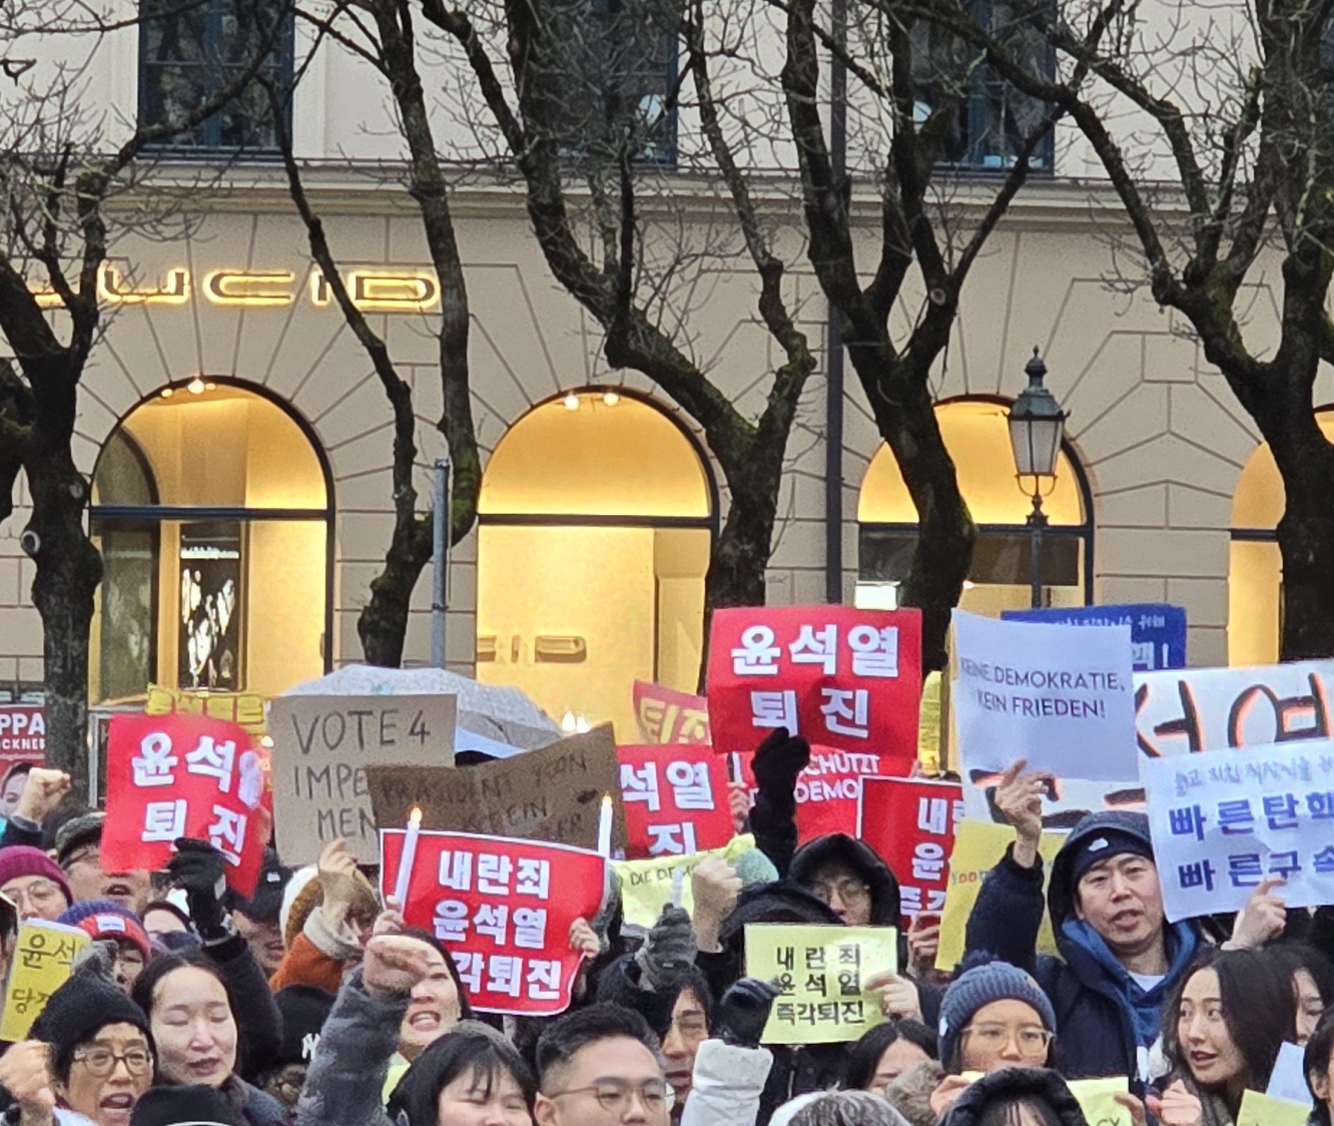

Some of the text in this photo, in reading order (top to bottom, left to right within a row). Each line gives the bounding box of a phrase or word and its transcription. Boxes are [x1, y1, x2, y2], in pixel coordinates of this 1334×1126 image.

[731, 623, 900, 678] 윤석열
[994, 666, 1126, 693] DEMOKRATIE,
[750, 687, 870, 739] 퇴진
[1012, 697, 1106, 719] FRIEDEN!
[291, 708, 431, 755] VOTE 4
[293, 764, 367, 800] IMPE
[620, 760, 715, 812] 석열
[317, 806, 376, 841] MEN
[438, 850, 550, 900] 내란죄
[433, 900, 548, 949] 윤석열
[451, 952, 562, 1000] 각퇴진
[777, 943, 861, 971] 내란죄
[778, 969, 862, 997] 윤석열
[776, 1000, 866, 1026] 즉각퇴진
